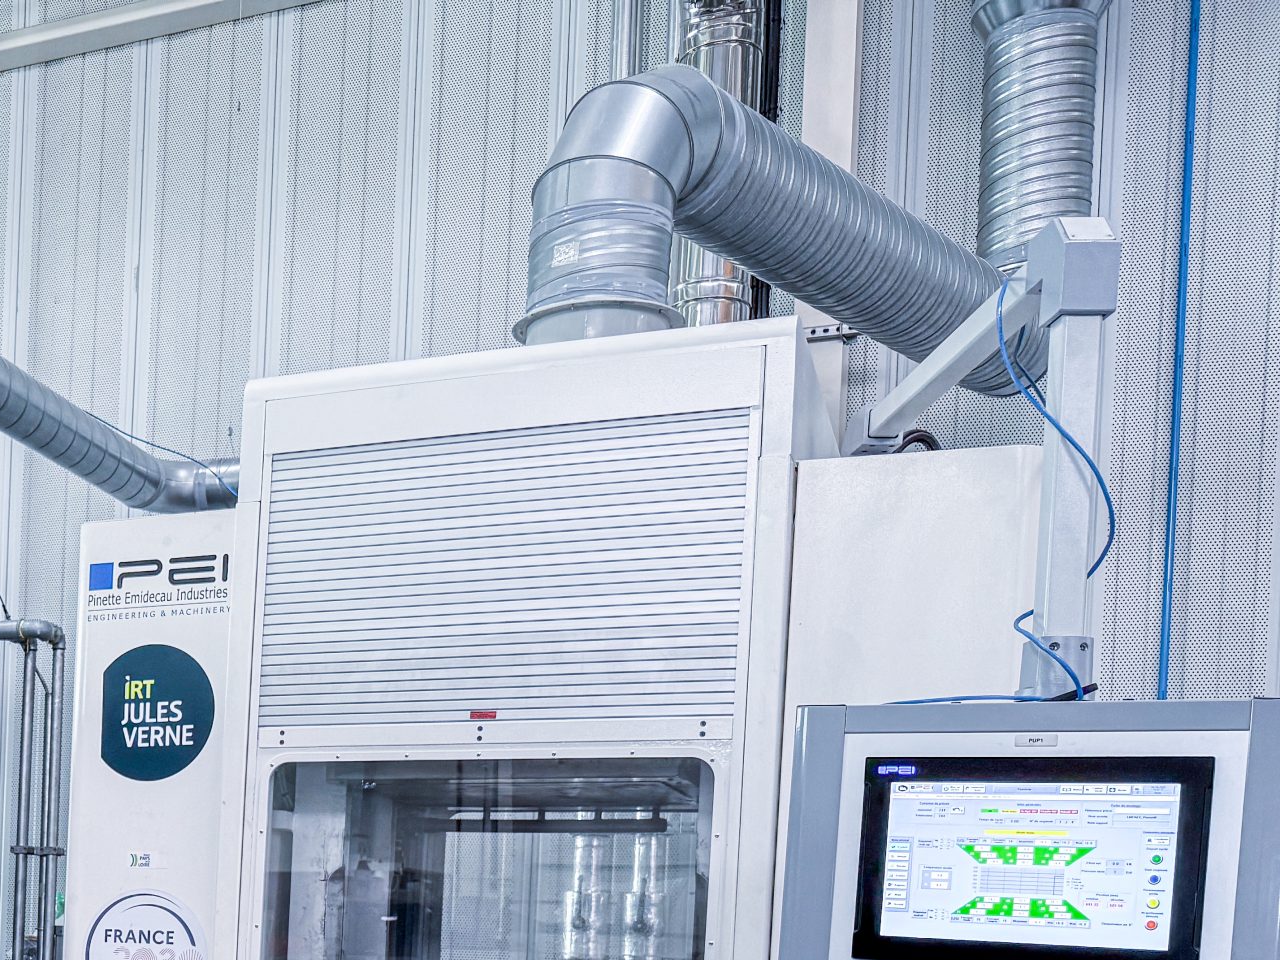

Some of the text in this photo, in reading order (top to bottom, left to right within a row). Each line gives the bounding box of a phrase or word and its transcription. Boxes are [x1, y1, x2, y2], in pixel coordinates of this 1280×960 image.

[117, 553, 229, 589] PEI
[88, 588, 228, 607] Pinette Emidecau Industries
[87, 610, 156, 622] ENGINEERING
[171, 606, 231, 616] MACHINERY
[120, 700, 183, 725] JULES
[122, 724, 194, 748] VERNE
[104, 929, 175, 945] FRANCE
